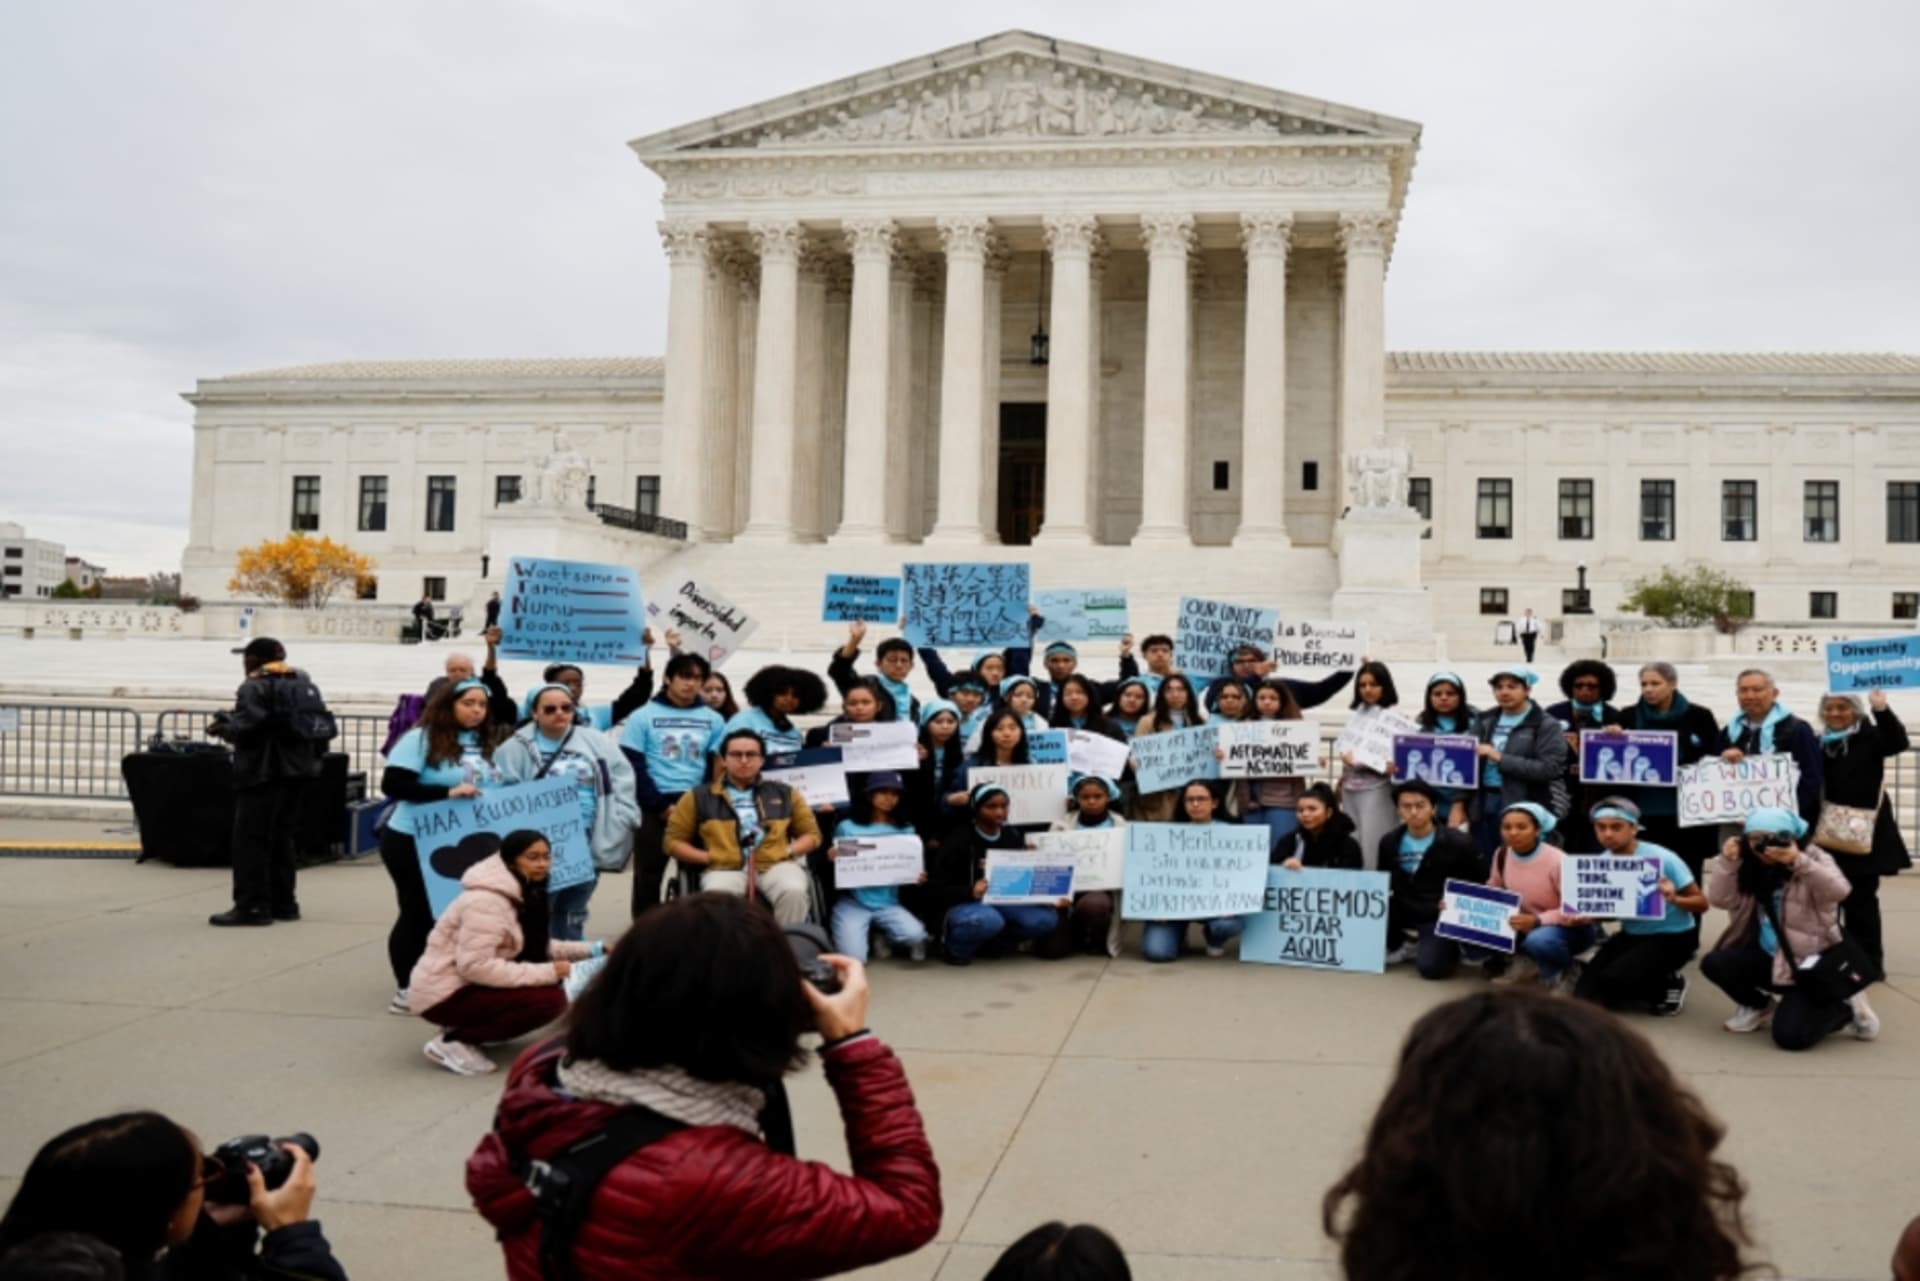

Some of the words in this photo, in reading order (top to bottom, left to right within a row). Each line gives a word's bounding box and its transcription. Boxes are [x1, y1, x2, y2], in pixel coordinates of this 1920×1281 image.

[1186, 598, 1218, 617] OUR
[1220, 603, 1263, 626] UNITY
[1842, 639, 1907, 657] Diversity
[1851, 674, 1903, 688] Justice
[1229, 742, 1310, 761] AFFIRMATIVE
[1247, 759, 1293, 775] ACTION
[1683, 766, 1710, 784] WE
[1686, 790, 1715, 814] GO
[413, 809, 462, 838] HAA
[1577, 858, 1590, 870] DO
[1593, 858, 1611, 870] THE
[1613, 859, 1645, 871] RIGHT
[1577, 887, 1624, 900] SUPREME
[1264, 887, 1386, 919] ERECEMOS
[1279, 915, 1343, 937] ESTAR
